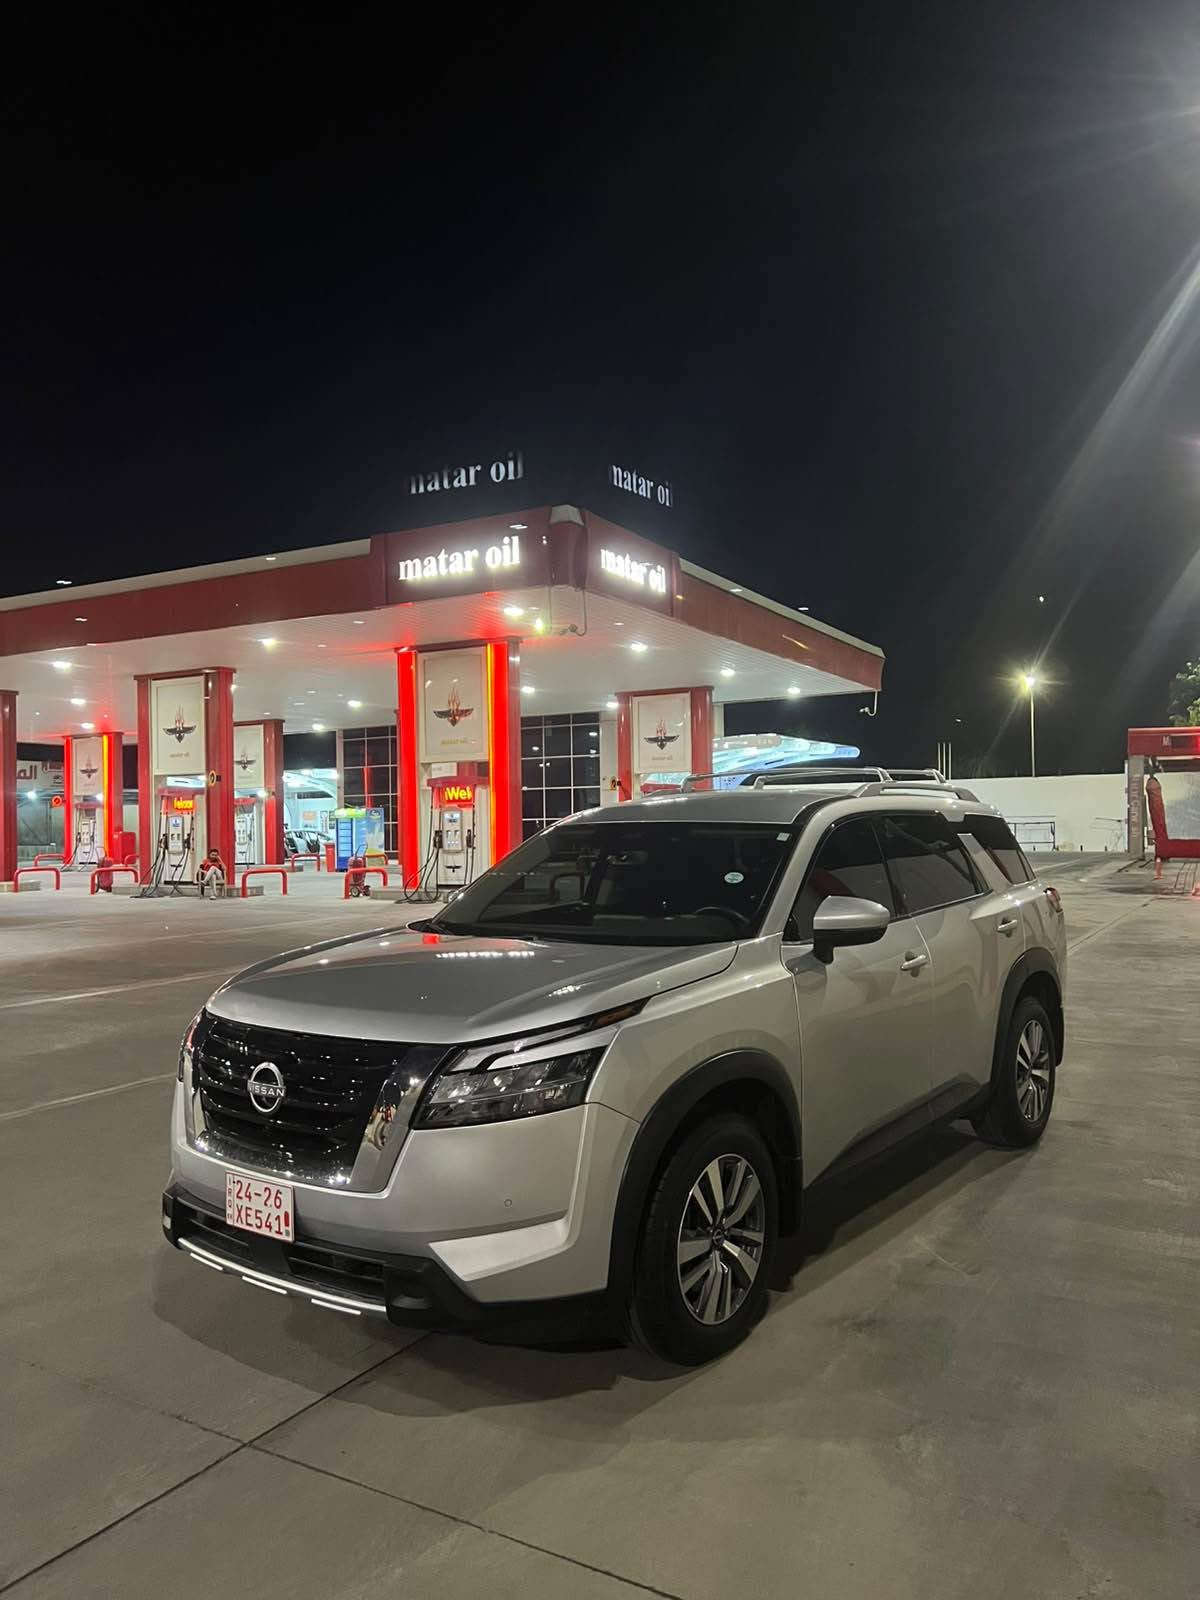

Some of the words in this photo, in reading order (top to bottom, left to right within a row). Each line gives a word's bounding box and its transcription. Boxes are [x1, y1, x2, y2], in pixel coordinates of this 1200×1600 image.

[490, 450, 524, 482] oil
[398, 548, 479, 580] matar
[485, 536, 520, 568] oil
[600, 549, 648, 585] matar
[649, 565, 666, 593] oil
[236, 1180, 283, 1210] 24-26
[236, 1204, 283, 1236] XE541
